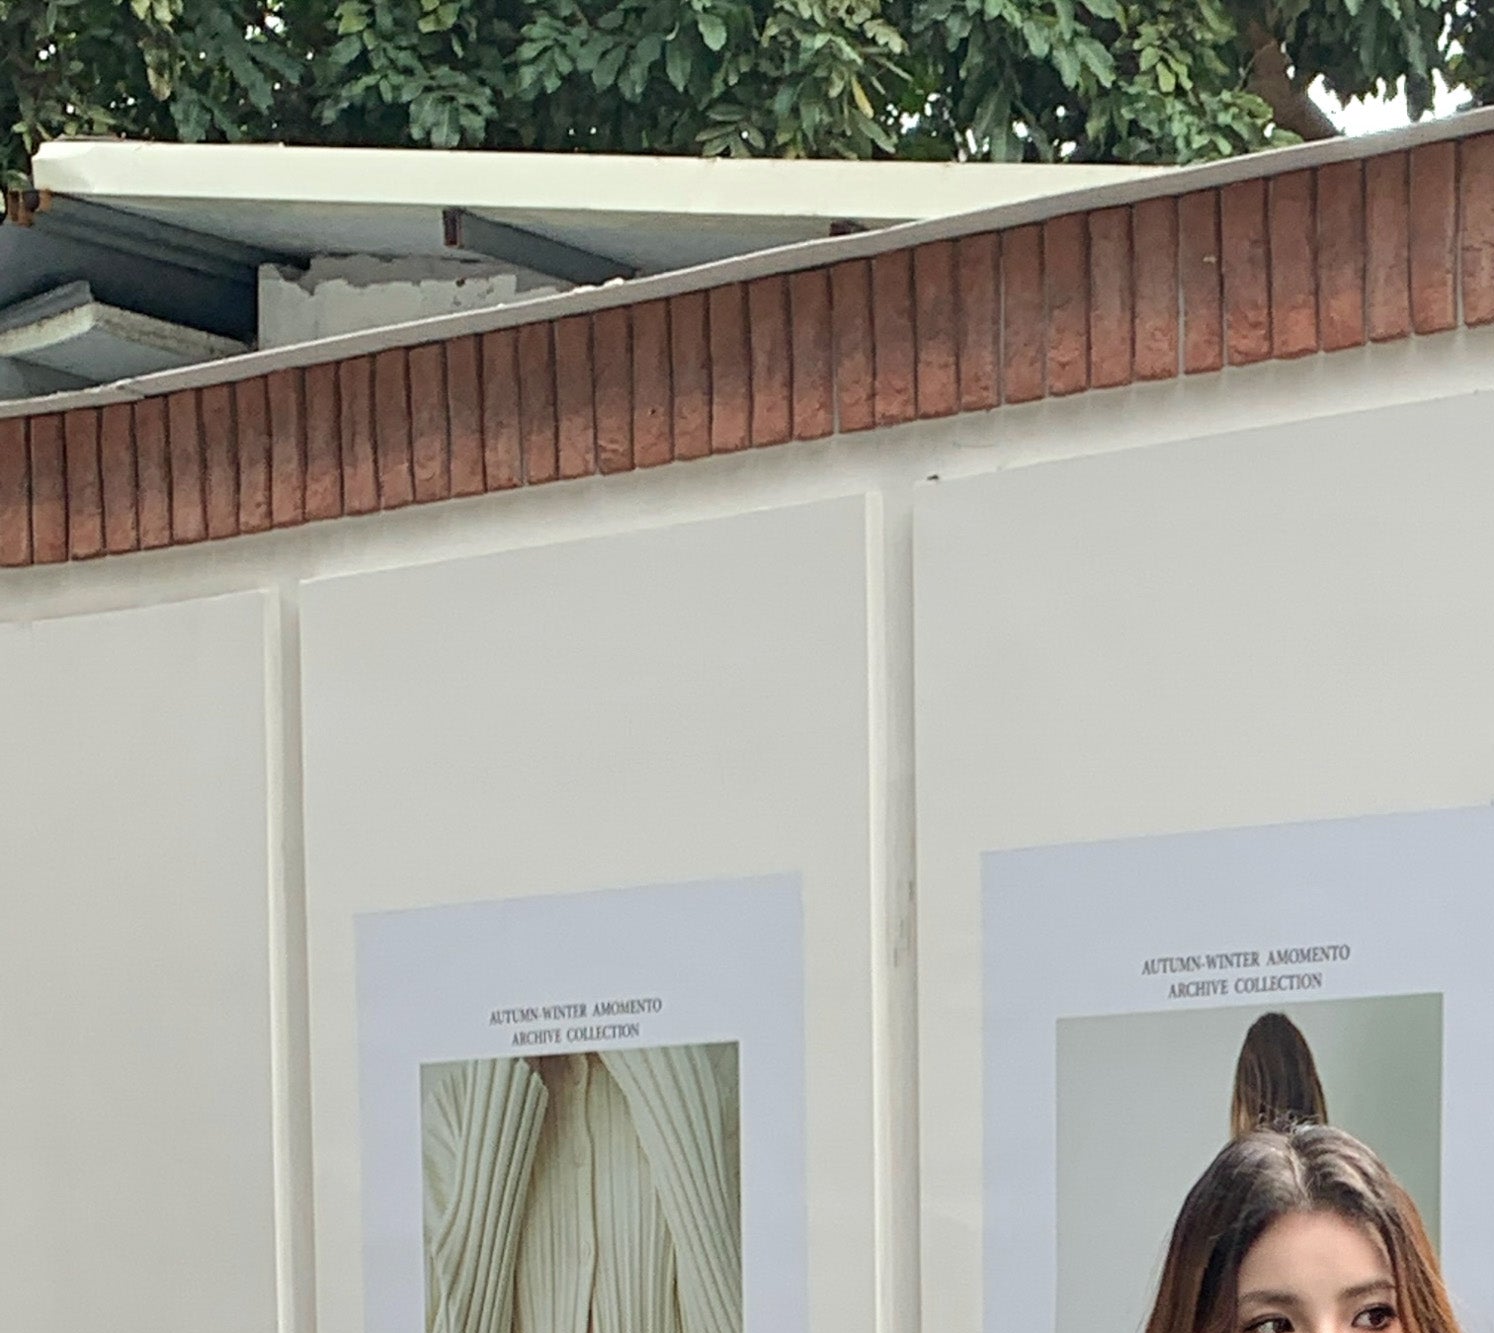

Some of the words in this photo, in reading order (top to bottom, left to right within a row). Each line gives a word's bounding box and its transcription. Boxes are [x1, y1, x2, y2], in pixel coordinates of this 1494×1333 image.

[1140, 950, 1261, 976] AUTUMN-WINTER
[1266, 944, 1351, 967] AMOMENTO
[1167, 978, 1229, 1000] ARCHIVE
[1234, 972, 1323, 995] COLLECTION
[592, 998, 663, 1018] AMOMENTO
[511, 1027, 562, 1047] ARCHIVE
[566, 1022, 640, 1044] COLLECTION
